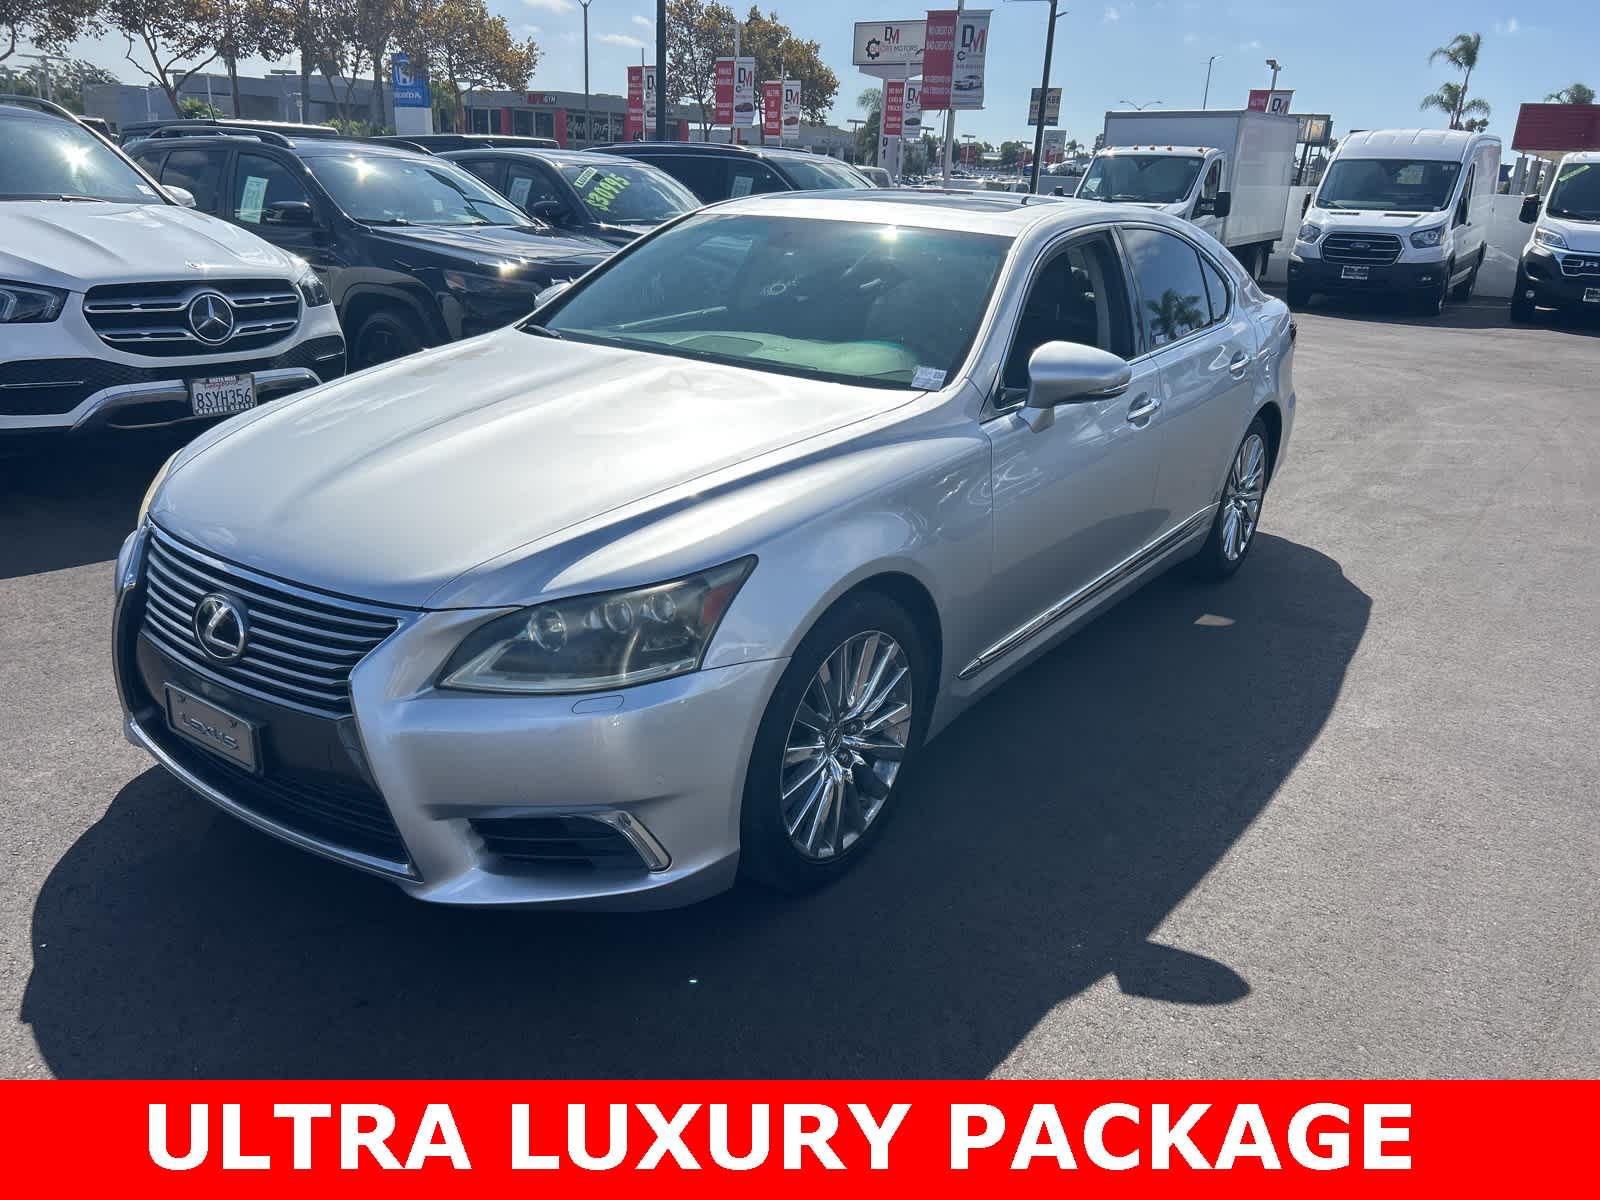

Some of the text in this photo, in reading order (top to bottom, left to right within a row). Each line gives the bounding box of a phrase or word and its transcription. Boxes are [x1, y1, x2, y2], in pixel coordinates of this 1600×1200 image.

[585, 173, 631, 211] $30995
[196, 387, 252, 409] 8SYH356
[181, 711, 240, 751] LEXUS
